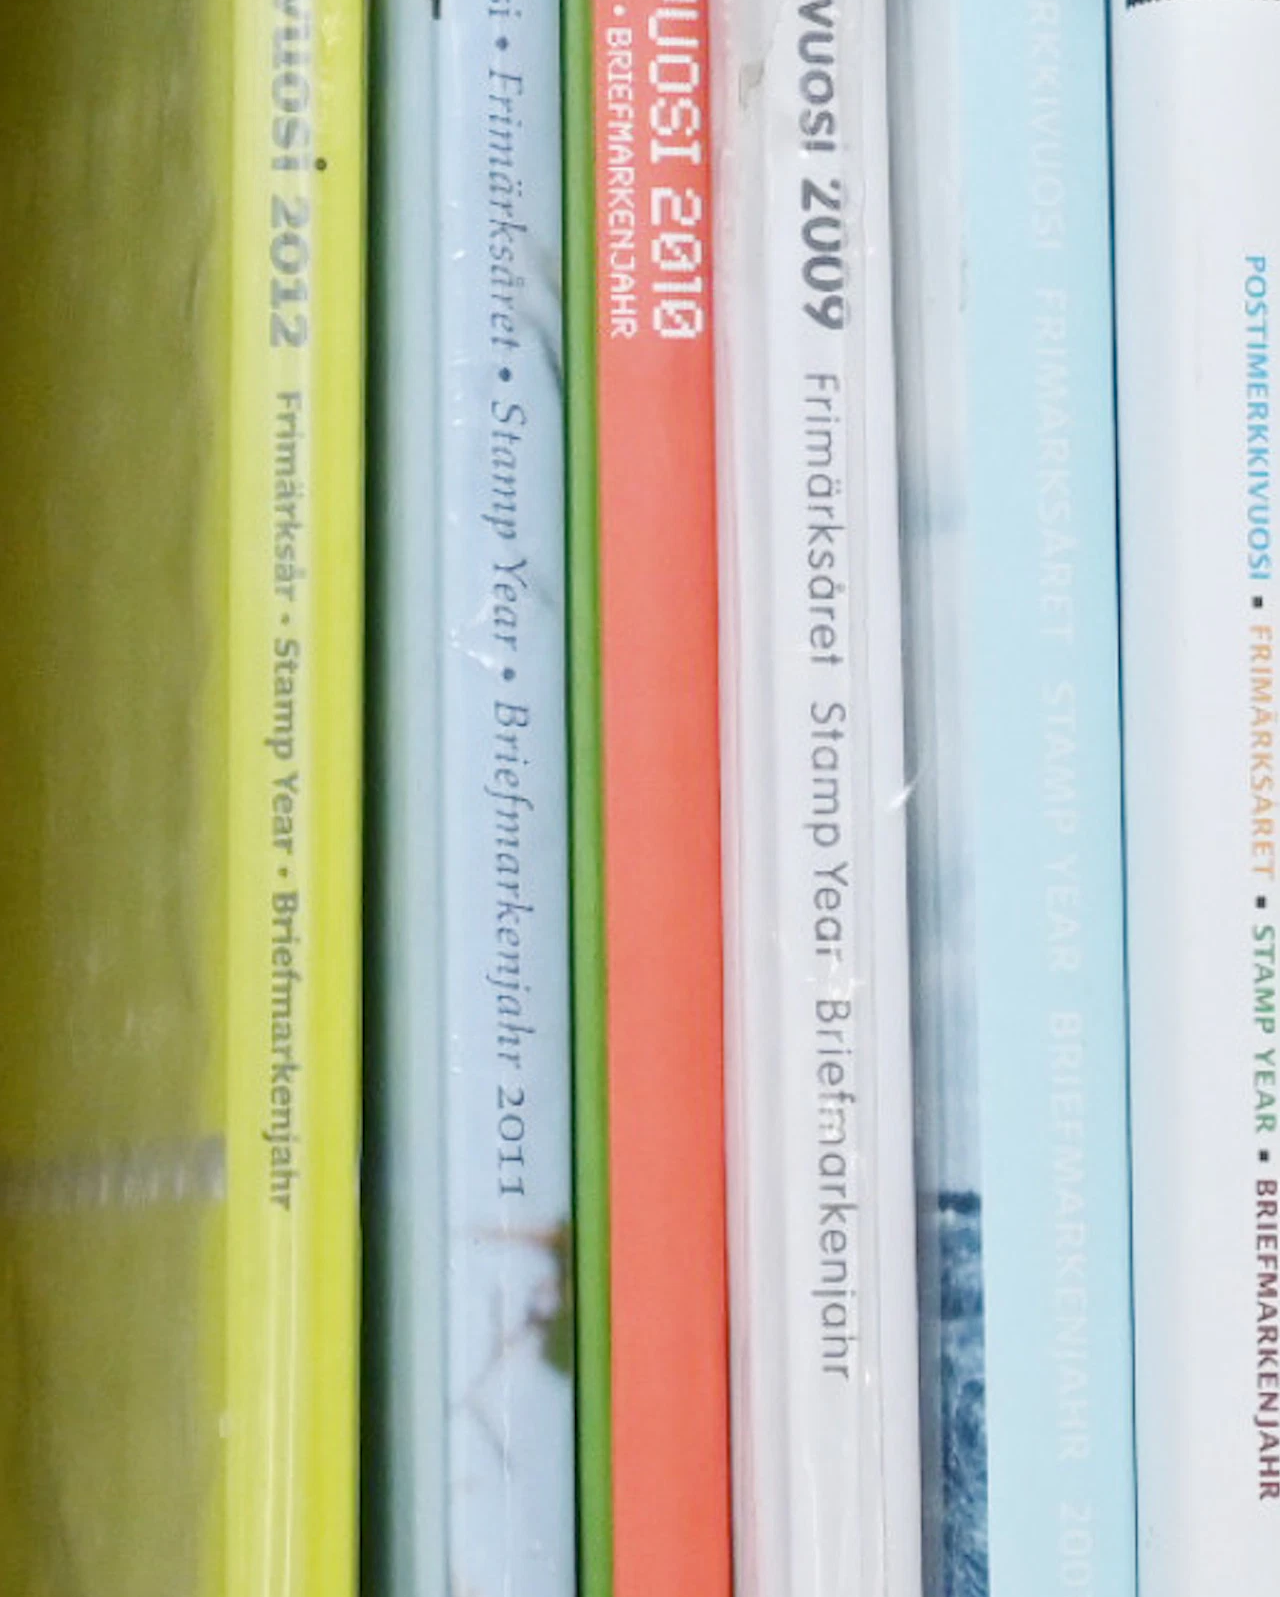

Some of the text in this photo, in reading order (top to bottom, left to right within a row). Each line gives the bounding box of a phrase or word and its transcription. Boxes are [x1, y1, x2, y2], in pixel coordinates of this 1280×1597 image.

[486, 66, 527, 348] Frimärksåret
[606, 27, 637, 337] BRIEFMARKENJAHR
[800, 179, 848, 331] 2009
[269, 195, 310, 347] 2012
[654, 187, 704, 339] 2010
[483, 400, 527, 539] Stamp
[1243, 254, 1274, 580] POSTIMERKKIVUOSI
[273, 390, 306, 601] Frimärksår
[803, 371, 847, 666] Frimärksåret
[493, 559, 528, 651] Year
[265, 637, 302, 760] Stamp
[272, 769, 301, 851] Year
[803, 701, 847, 849] Stamp
[486, 701, 531, 1069] Briefmarkenjahr
[812, 860, 848, 959] Year
[264, 890, 302, 1211] Briefmarkenjahr
[1253, 925, 1278, 1034] STAMP
[496, 1086, 528, 1197] 2011
[1253, 1048, 1279, 1133] YEAR
[805, 999, 859, 1379] Briefmarkenjahr
